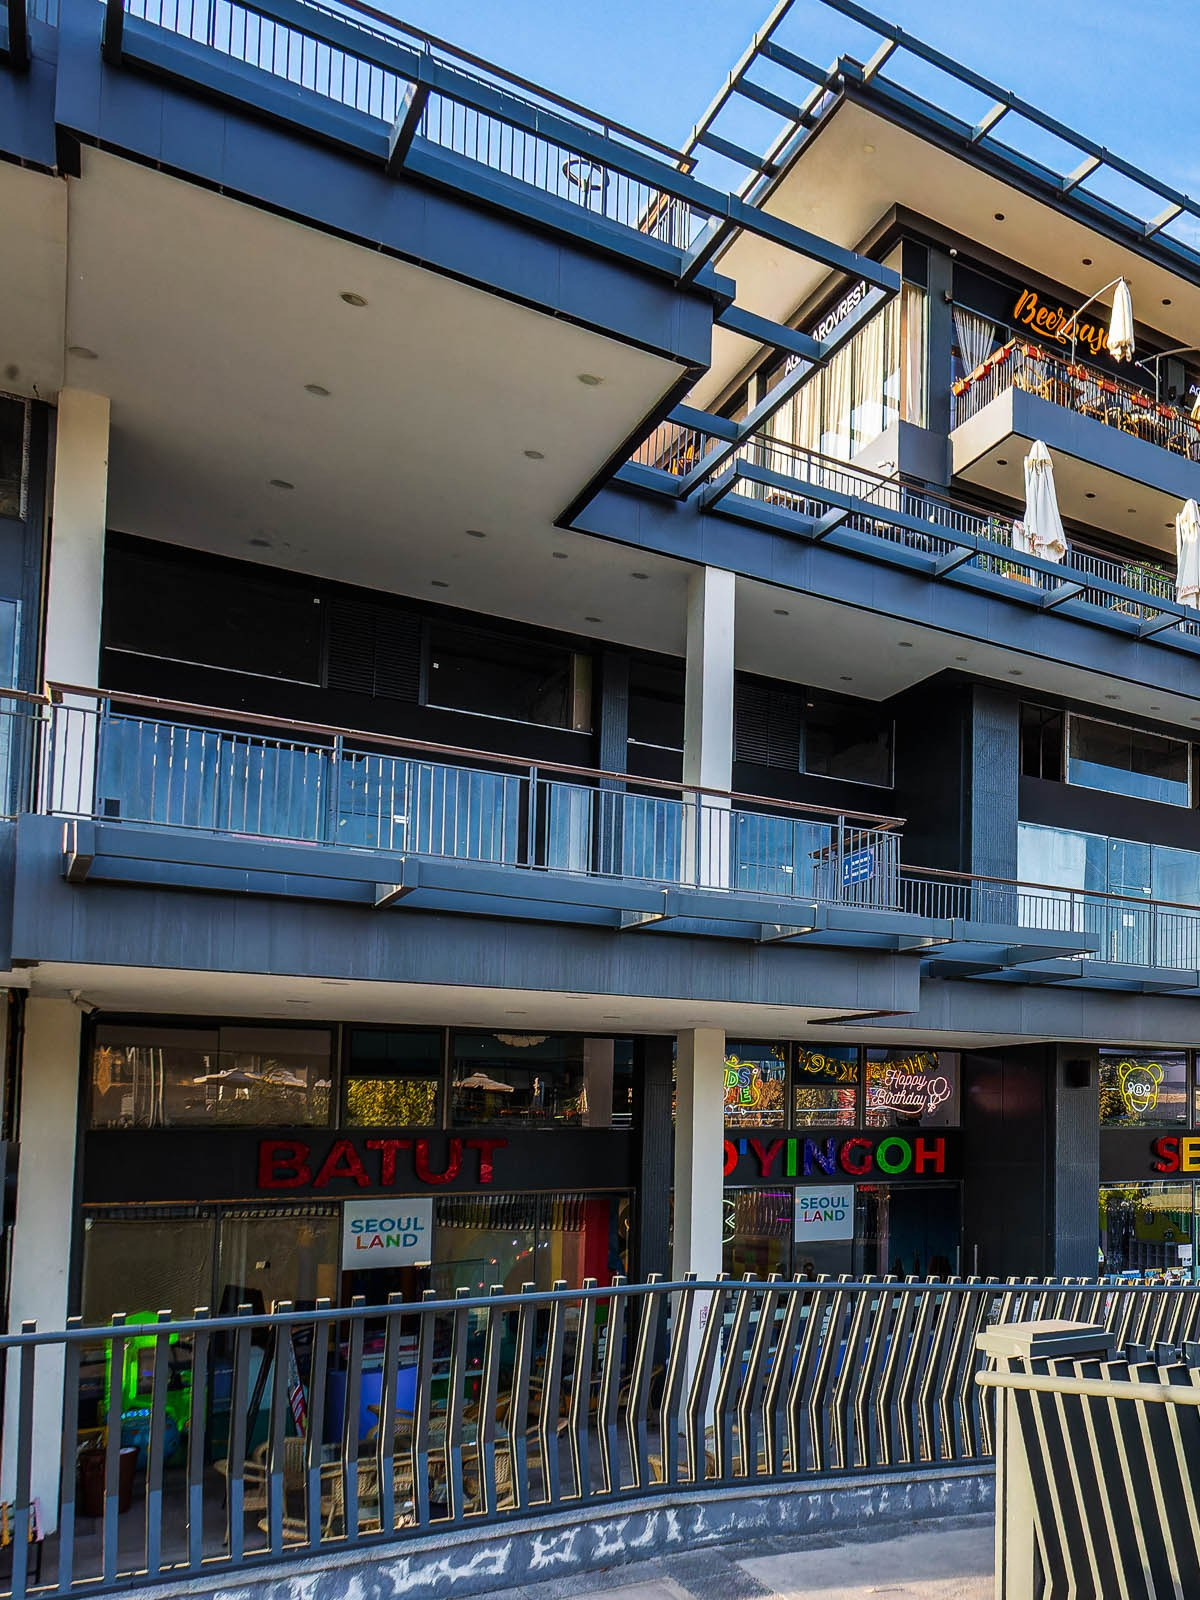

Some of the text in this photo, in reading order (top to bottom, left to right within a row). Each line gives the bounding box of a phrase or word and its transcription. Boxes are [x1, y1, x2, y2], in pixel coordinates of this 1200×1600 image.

[884, 1069, 928, 1091] Happy
[872, 1088, 928, 1110] Birthday
[258, 1138, 509, 1189] BATUT
[801, 1196, 849, 1209] SEOUL
[351, 1216, 425, 1234] SEOUL
[804, 1209, 845, 1223] LAND
[356, 1233, 418, 1249] LAND
